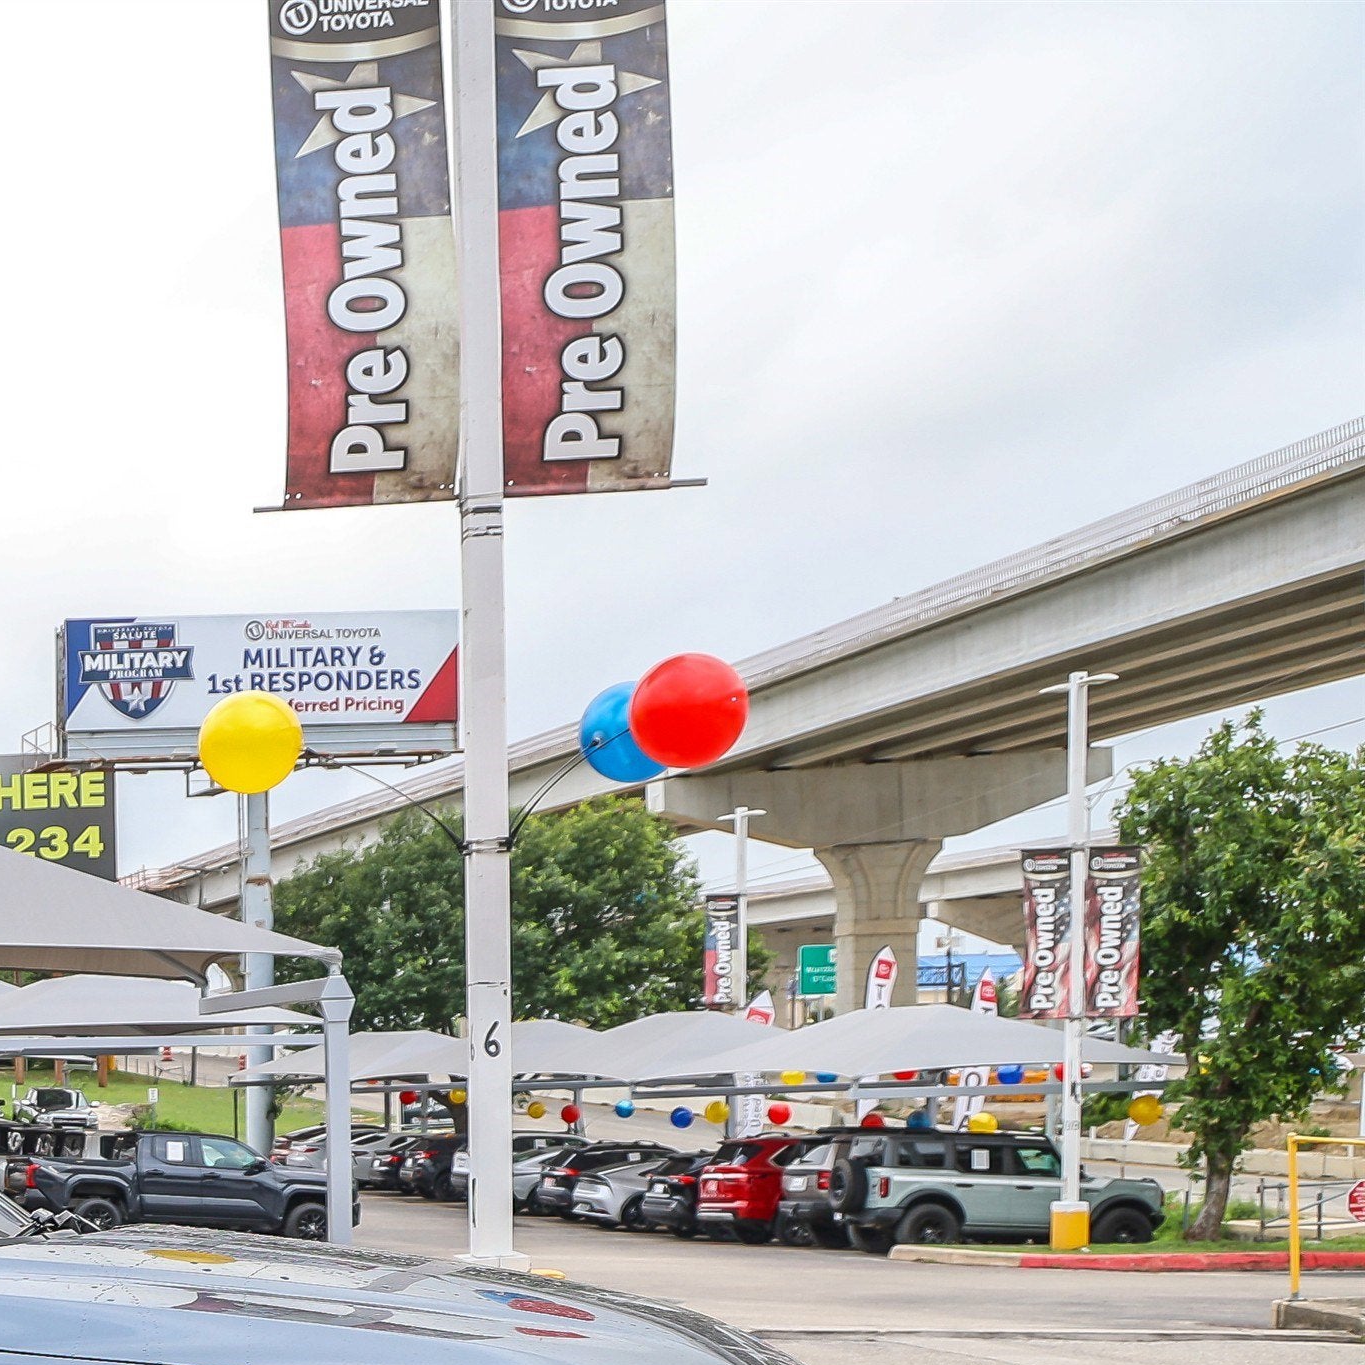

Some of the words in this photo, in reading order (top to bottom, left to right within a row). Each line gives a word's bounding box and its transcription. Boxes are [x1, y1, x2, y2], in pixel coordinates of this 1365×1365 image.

[319, 11, 395, 32] TOYOTA
[315, 85, 408, 333] Owned
[536, 64, 625, 320] Owned
[329, 348, 409, 474] Pre
[542, 335, 626, 462] Pre
[112, 630, 157, 640] SALUTE
[266, 629, 334, 640] UNIVERSAL
[335, 627, 382, 639] TOYOTA
[83, 650, 188, 672] MILITARY
[108, 669, 163, 680] PROGRAM
[243, 645, 364, 669] MILITARY
[369, 645, 387, 667] &
[207, 673, 243, 694] 1st
[250, 669, 422, 693] RESPONDERS
[290, 697, 340, 713] ferred
[345, 697, 405, 715] Pricing
[1032, 887, 1056, 967] Owned
[1095, 886, 1124, 966] Owned
[712, 920, 732, 975] Owned
[712, 976, 732, 1004] Pre
[1030, 970, 1055, 1010] Pre
[1095, 969, 1121, 1009] Pre
[484, 1020, 502, 1058] 6
